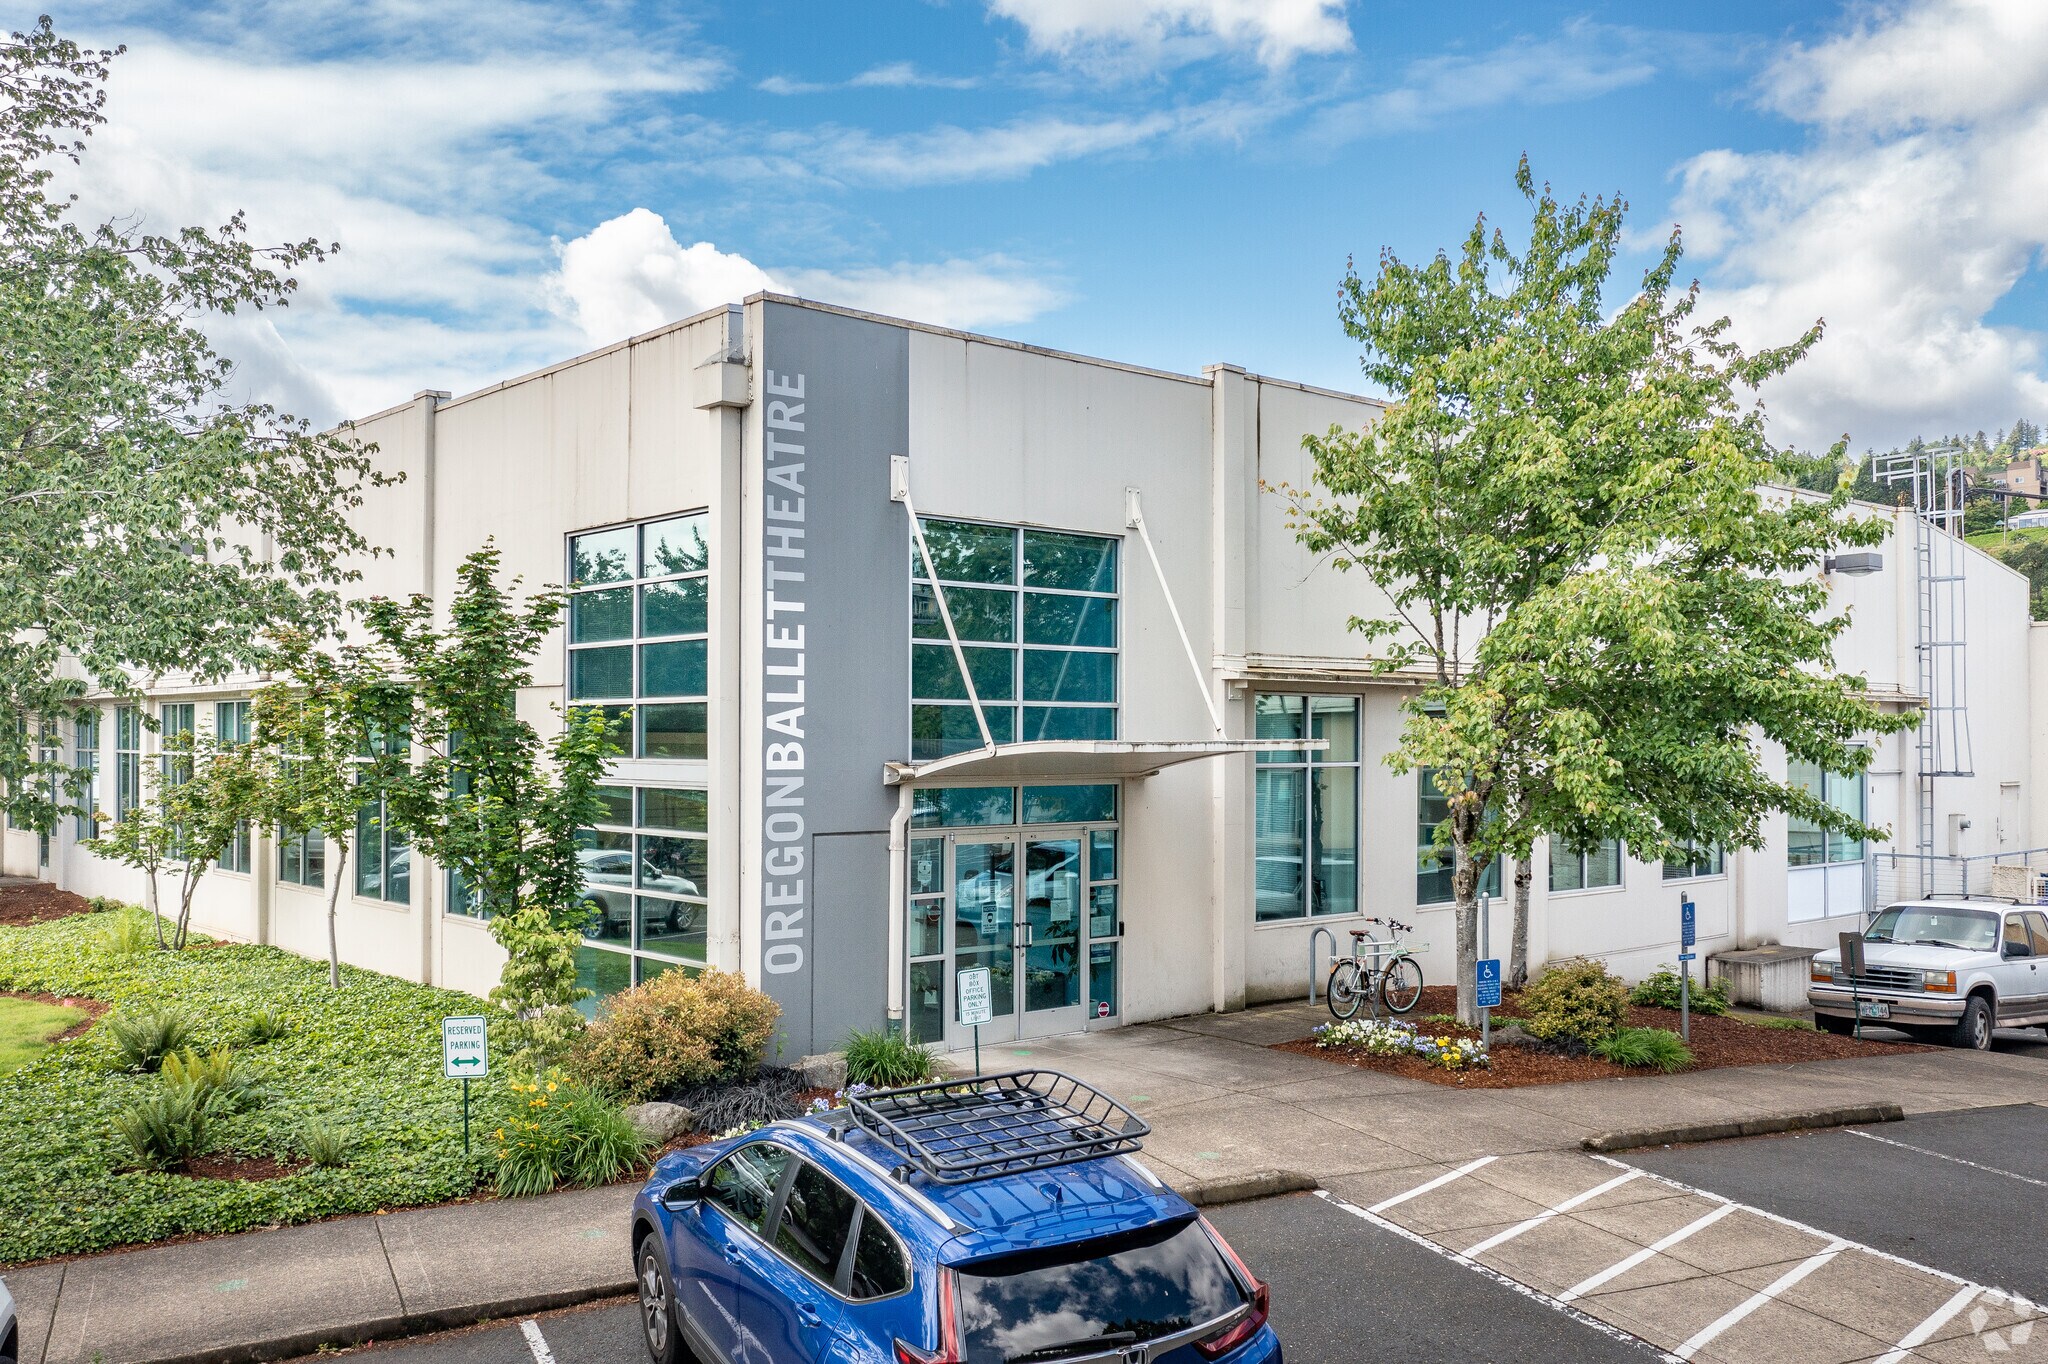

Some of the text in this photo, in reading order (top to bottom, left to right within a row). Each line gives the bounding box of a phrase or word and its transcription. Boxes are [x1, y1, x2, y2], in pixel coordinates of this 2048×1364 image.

[964, 993, 986, 1002] PARKING
[448, 1026, 482, 1035] RESERVED
[450, 1041, 480, 1049] PARKING
